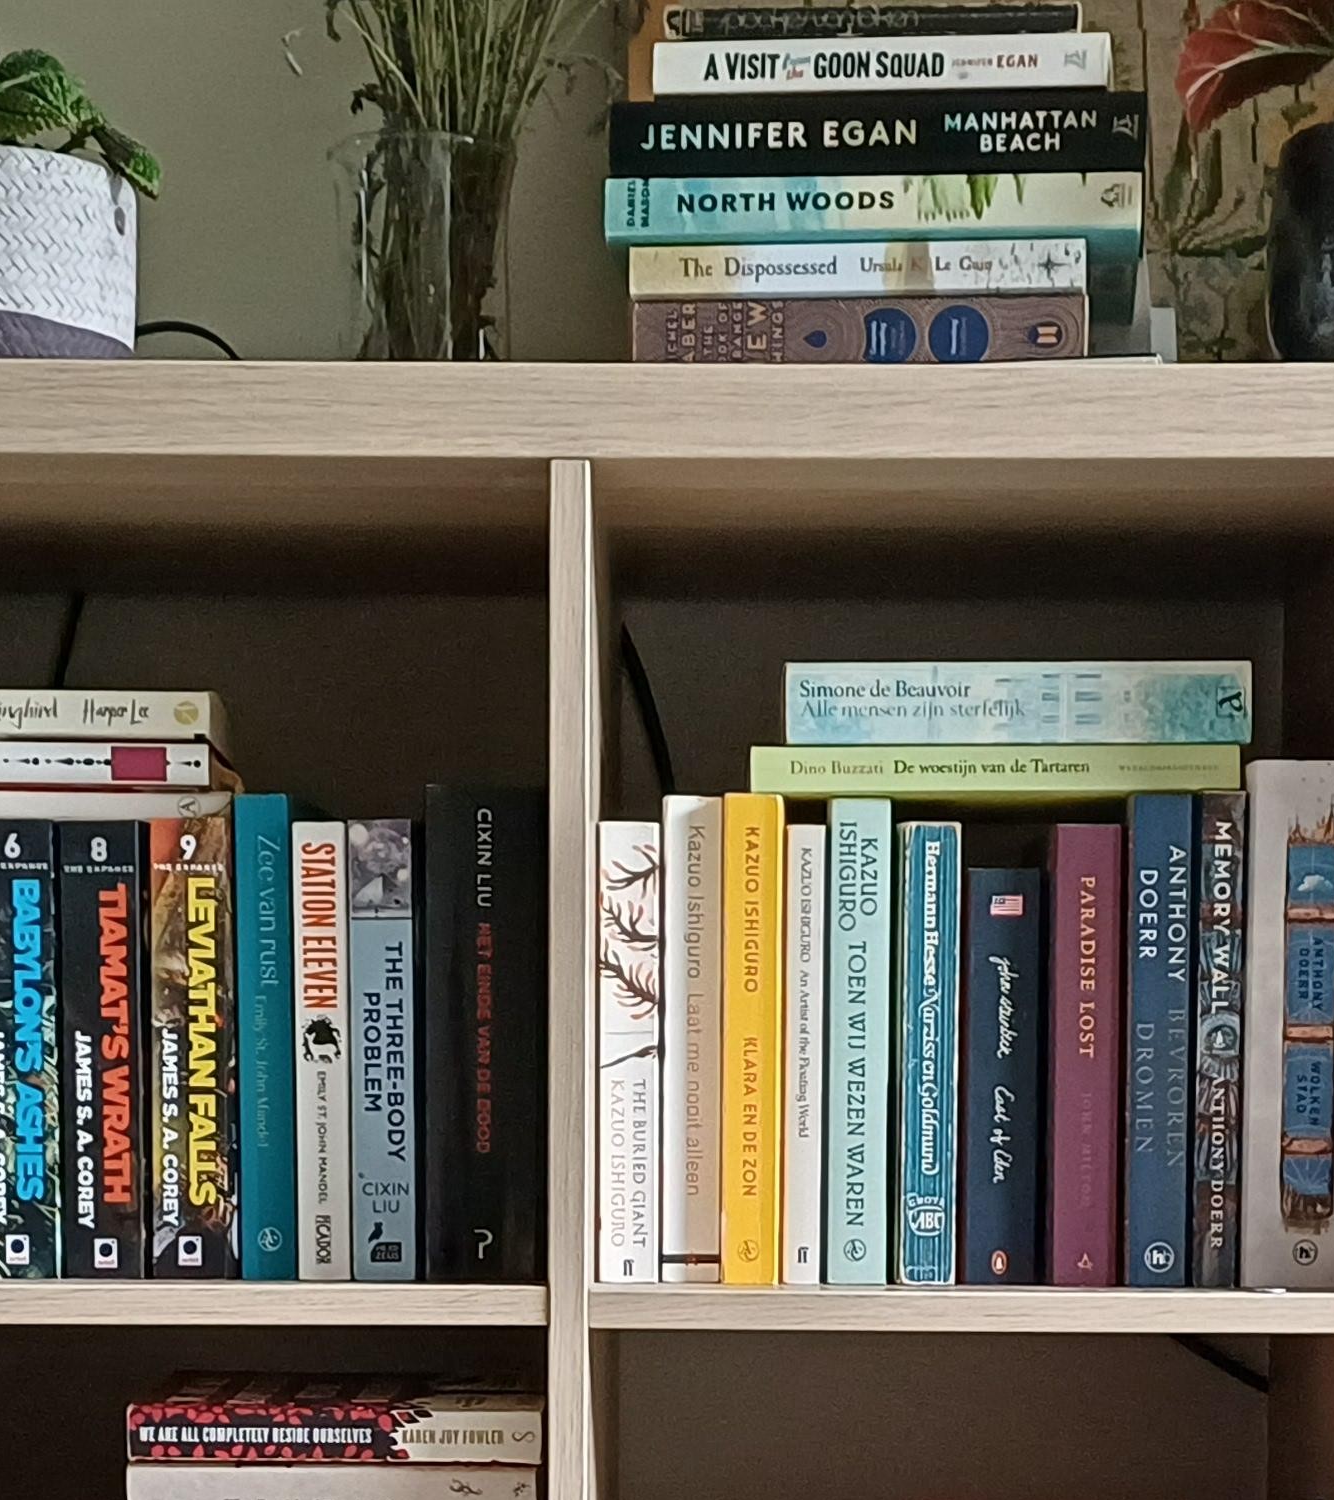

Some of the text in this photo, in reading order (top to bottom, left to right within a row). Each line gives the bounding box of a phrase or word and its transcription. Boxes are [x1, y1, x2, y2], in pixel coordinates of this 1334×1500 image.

[704, 54, 720, 80] A
[725, 54, 780, 79] VISIT
[814, 52, 870, 78] GOON
[876, 52, 944, 78] SQUAD
[641, 120, 917, 151] JENNIFER EGAN
[944, 111, 1097, 132] MANHATTAN
[980, 133, 1061, 153] BEACH
[677, 191, 894, 213] NORTH WOODS
[679, 257, 837, 279] The Dispossessed
[800, 680, 970, 699] Simone de Beauvoir
[5, 834, 21, 858] 6
[91, 838, 108, 861] 8
[180, 834, 197, 859] 9
[477, 808, 492, 908] CIXIN LIU
[301, 842, 337, 1009] STATION ELEVEN
[1138, 870, 1158, 960] DOERR
[1167, 845, 1187, 983] ANTHONY
[742, 826, 761, 1198] KAZUO ISHIGURO KLARA EN DE ZON
[1076, 877, 1097, 1059] PARADISE LOST
[10, 879, 44, 1202] BABYLON'S ASHES
[98, 882, 130, 1204] TIAMAT'S WRATH
[186, 876, 217, 1207] LEVIATHAN FALLS
[363, 993, 382, 1113] PROBLEM
[385, 942, 406, 1163] THE THREE-BODY
[846, 941, 866, 1228] TOEN WIJ WEZEN WAREN
